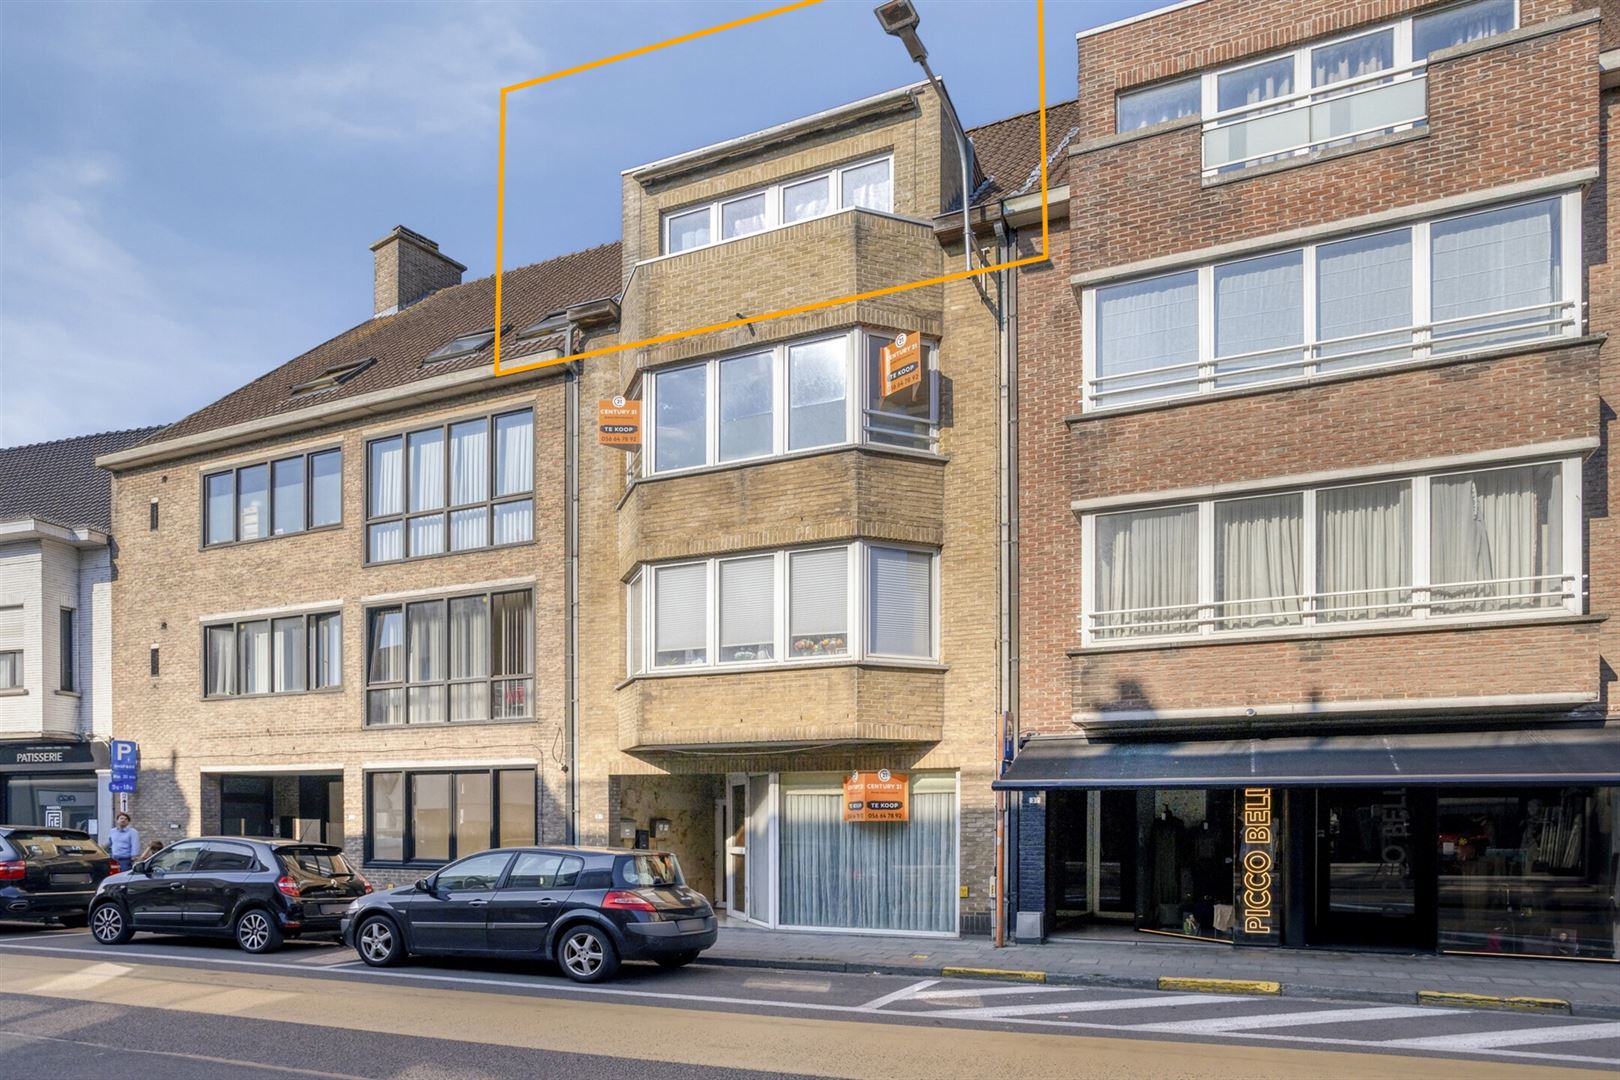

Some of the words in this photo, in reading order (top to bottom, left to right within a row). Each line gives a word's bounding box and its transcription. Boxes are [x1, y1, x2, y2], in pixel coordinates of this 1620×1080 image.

[897, 364, 915, 376] KOOP
[16, 752, 63, 762] PATISSERIE
[117, 743, 131, 760] P
[1244, 850, 1272, 934] PICCO
